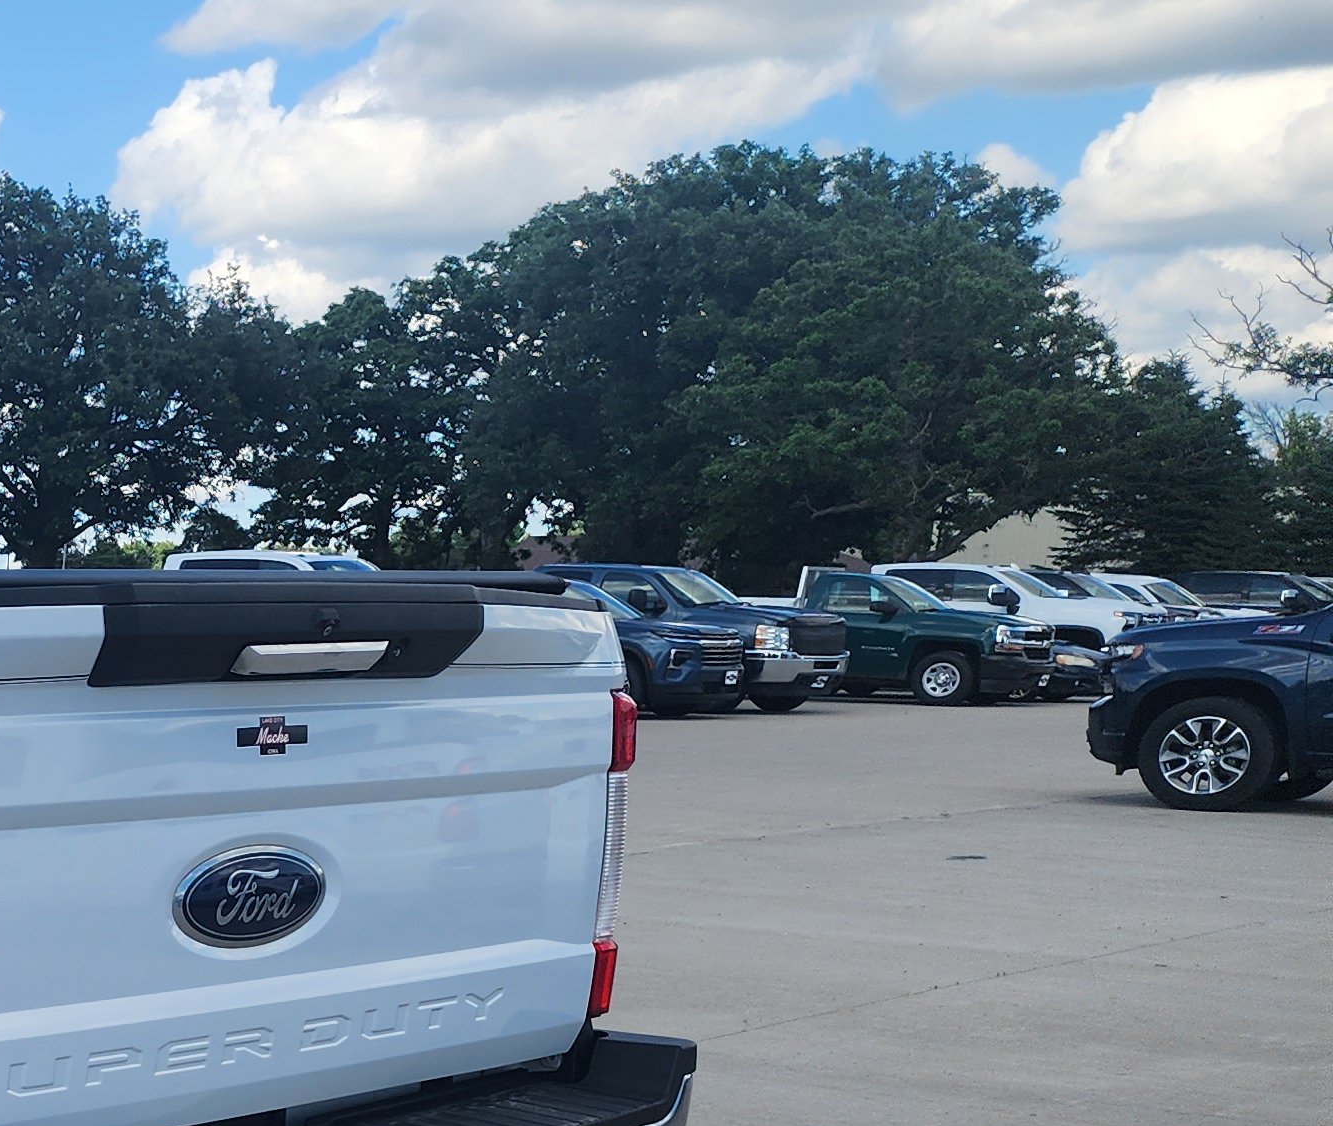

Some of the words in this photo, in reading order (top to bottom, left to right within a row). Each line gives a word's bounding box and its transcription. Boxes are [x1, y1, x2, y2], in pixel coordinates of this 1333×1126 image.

[255, 725, 290, 745] Macke
[216, 868, 299, 926] Ford
[299, 987, 505, 1053] DUTY
